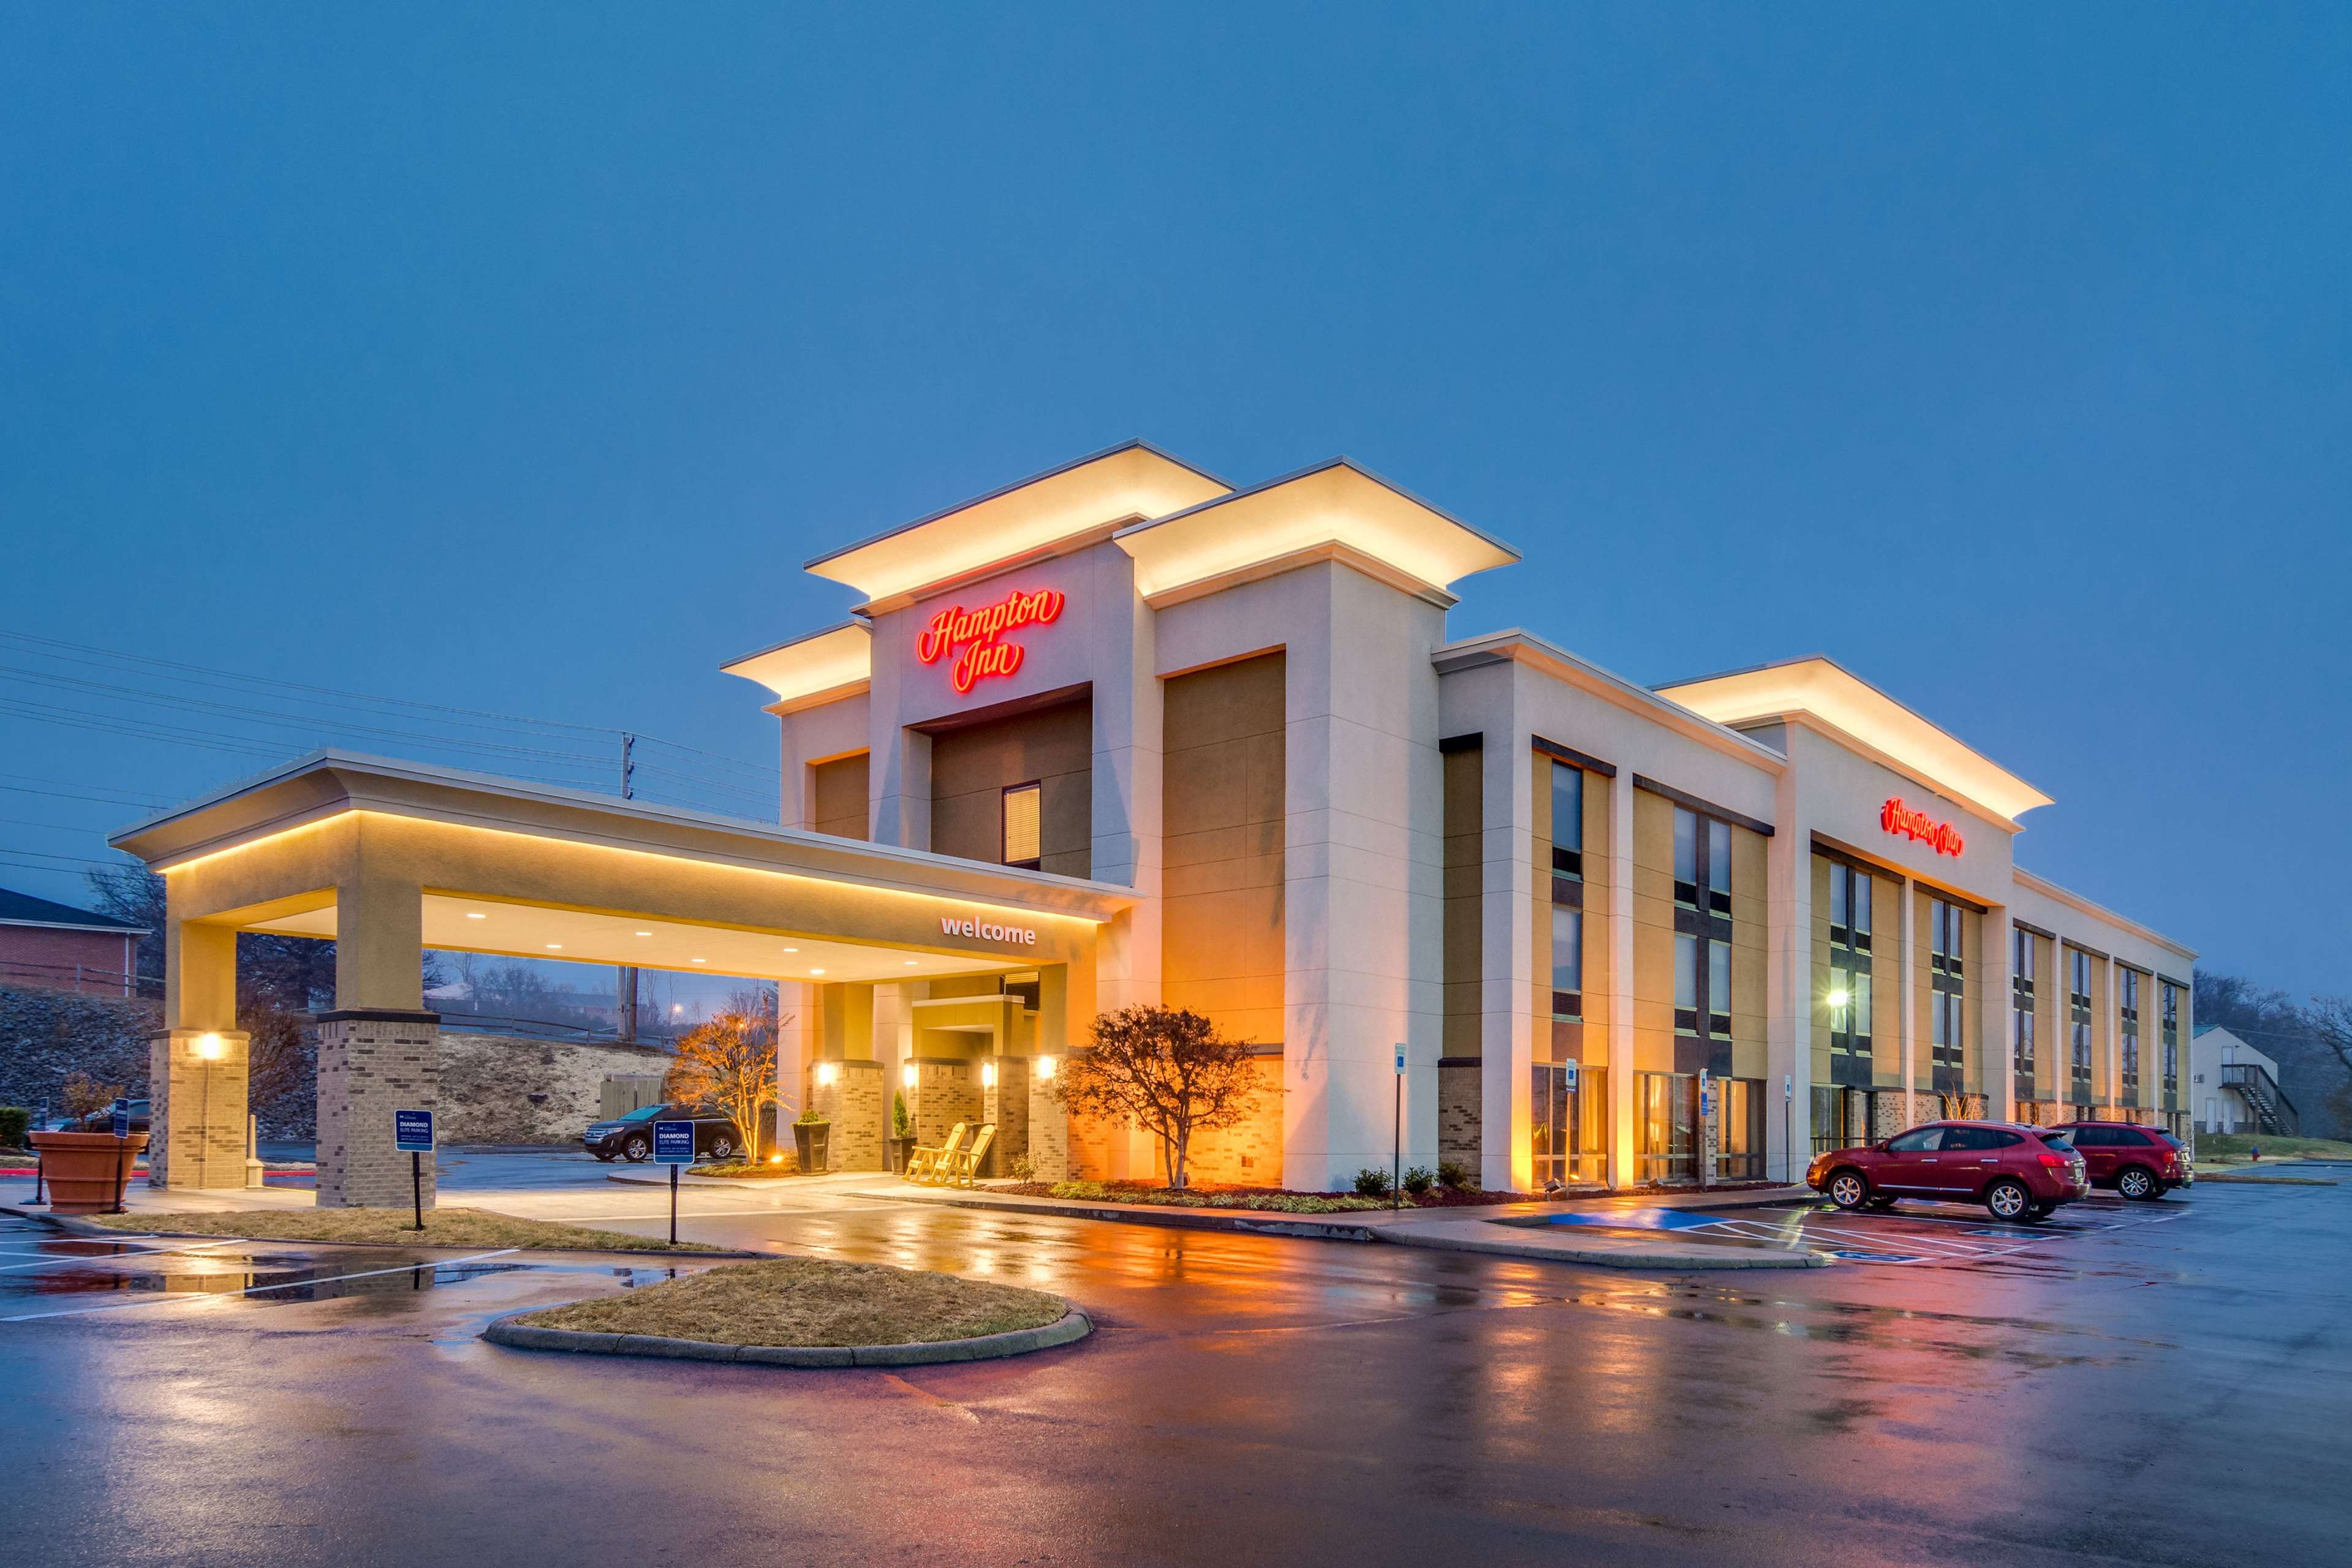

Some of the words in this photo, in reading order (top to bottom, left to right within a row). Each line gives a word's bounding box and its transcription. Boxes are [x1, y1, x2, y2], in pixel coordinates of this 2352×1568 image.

[918, 590, 1064, 663] Hampton
[953, 639, 1024, 693] Inn
[1881, 797, 1938, 846] Hampton
[1937, 823, 1964, 856] Inn
[940, 916, 1036, 945] welcome
